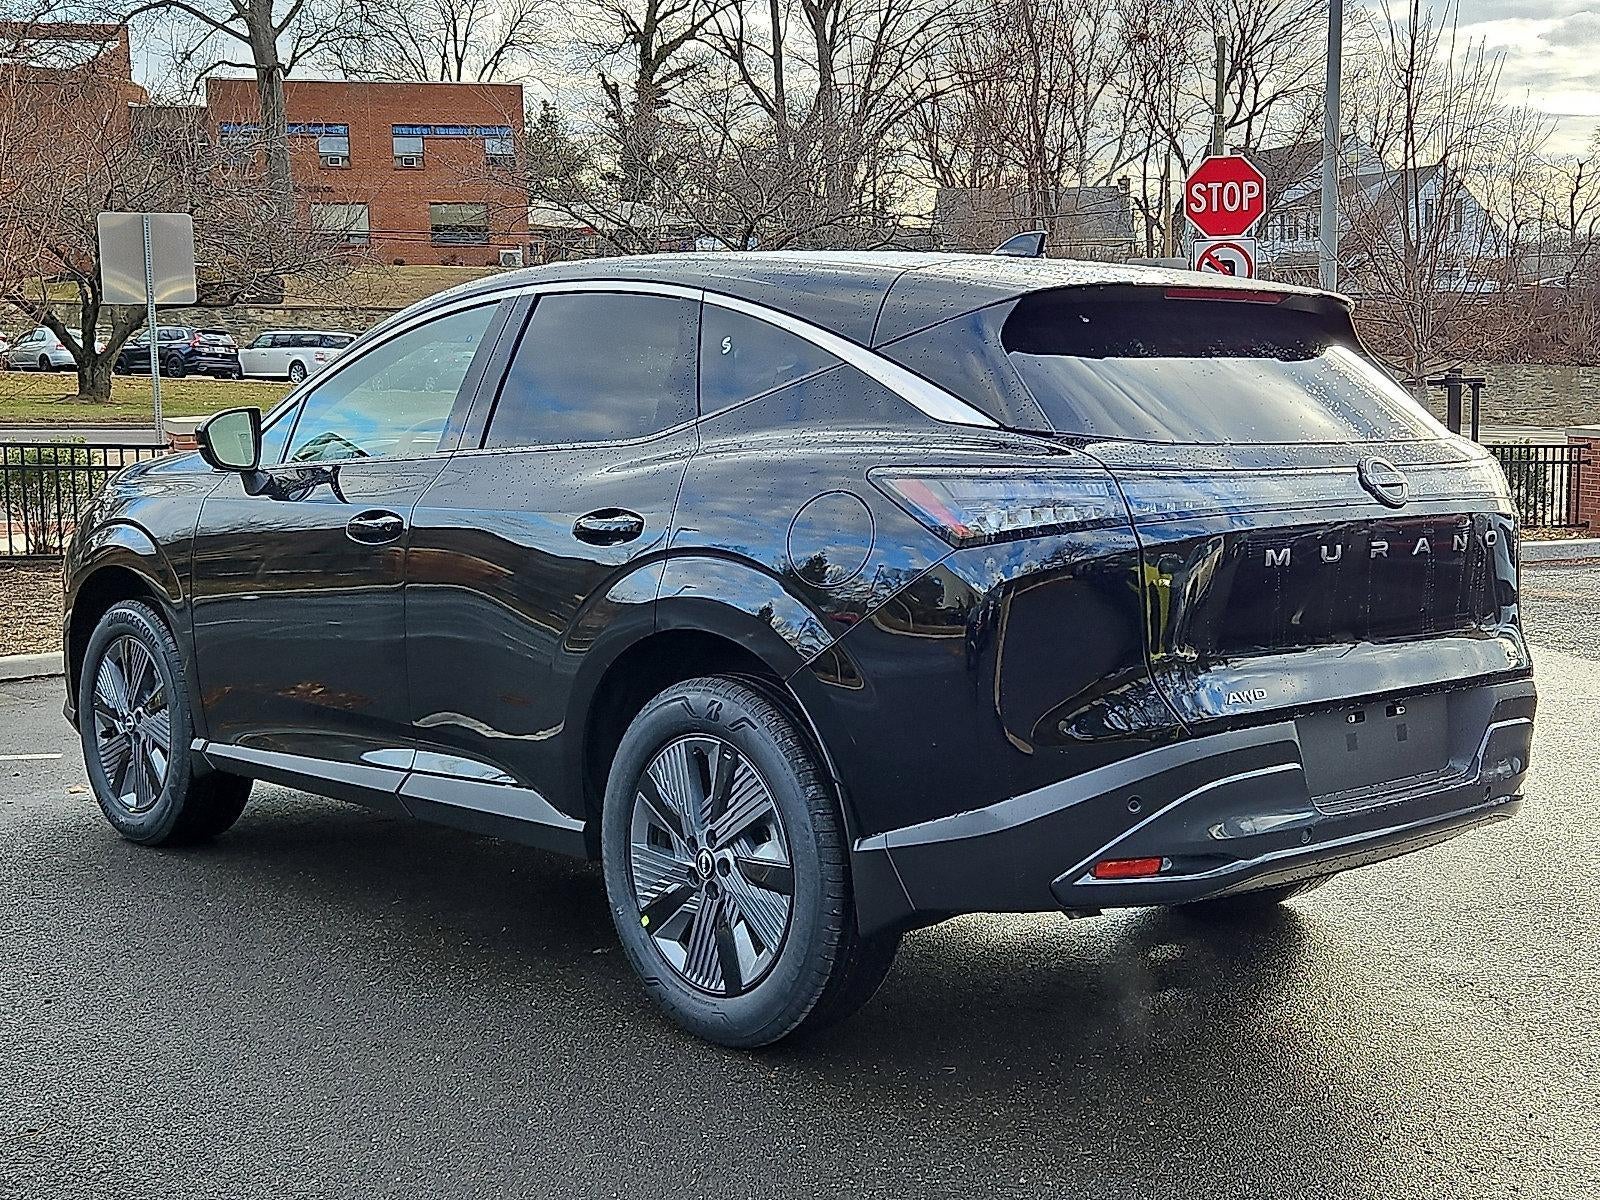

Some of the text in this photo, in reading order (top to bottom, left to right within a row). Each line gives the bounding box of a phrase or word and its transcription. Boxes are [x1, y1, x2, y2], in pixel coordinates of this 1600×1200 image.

[1189, 181, 1260, 213] STOP
[1265, 530, 1498, 567] MURANO
[107, 611, 160, 650] BRIDGESTONE
[1226, 687, 1268, 706] AWD
